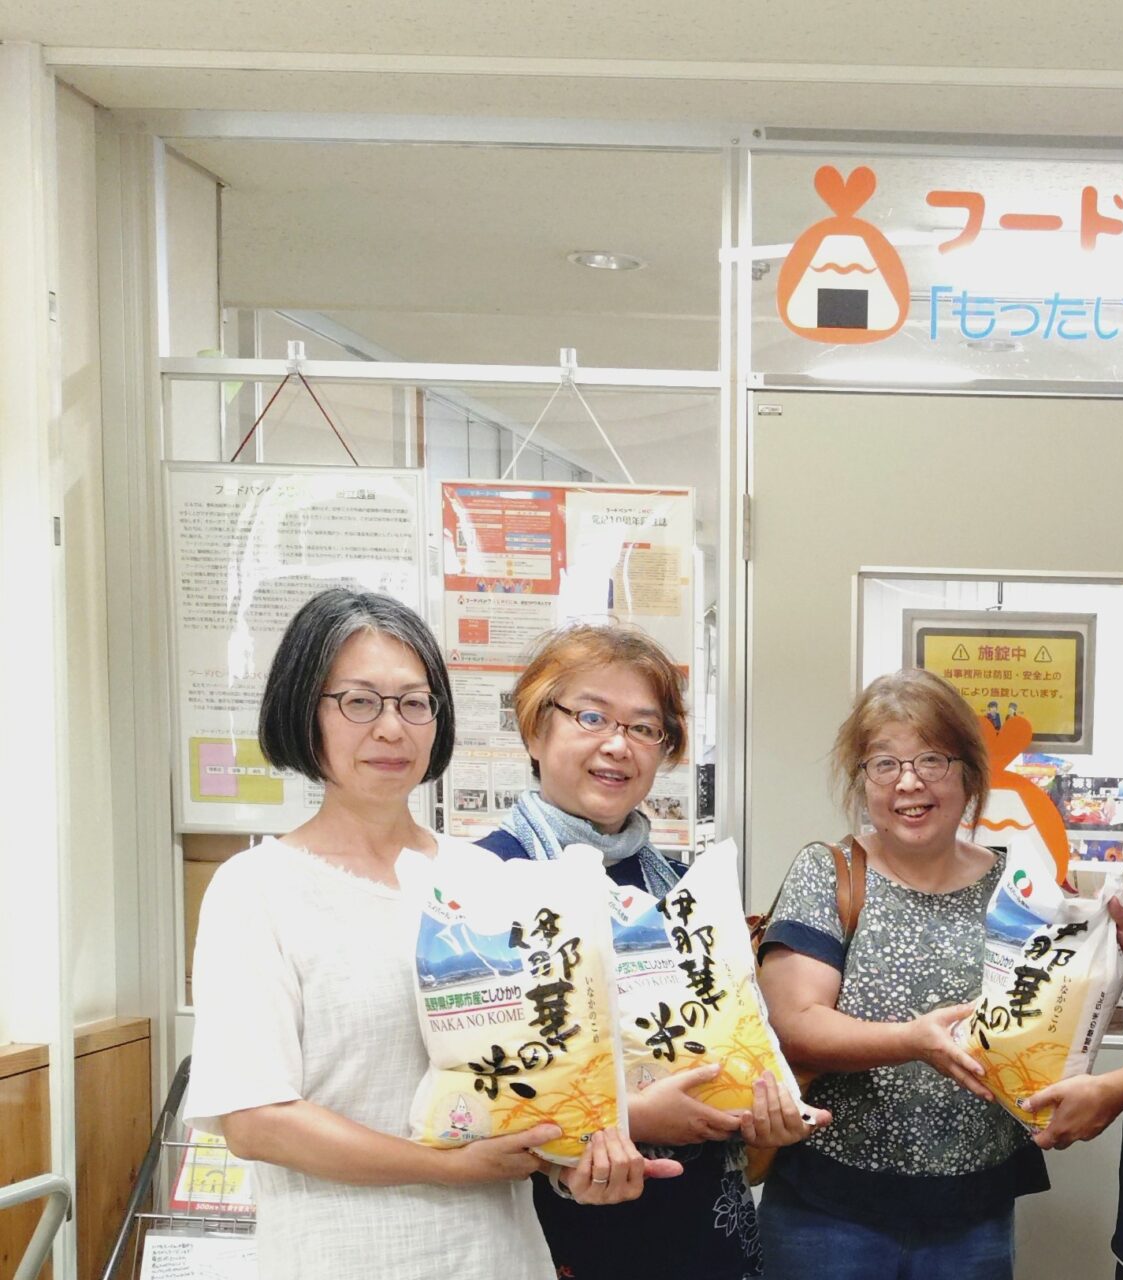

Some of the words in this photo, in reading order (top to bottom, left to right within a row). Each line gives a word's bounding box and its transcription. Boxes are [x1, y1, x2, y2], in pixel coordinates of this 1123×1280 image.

[977, 645, 1027, 662] 施錠中
[943, 668, 1062, 681] 当事務所は防犯・安全上の
[960, 687, 1063, 699] により施錠しています。
[635, 888, 728, 1063] 伊那華の米
[424, 985, 522, 1011] 長野県伊那市産こしひかり
[468, 907, 582, 1102] 伊那華の米
[430, 1015, 464, 1032] INAKA
[466, 1013, 485, 1027] NO
[487, 1008, 526, 1024] KOME
